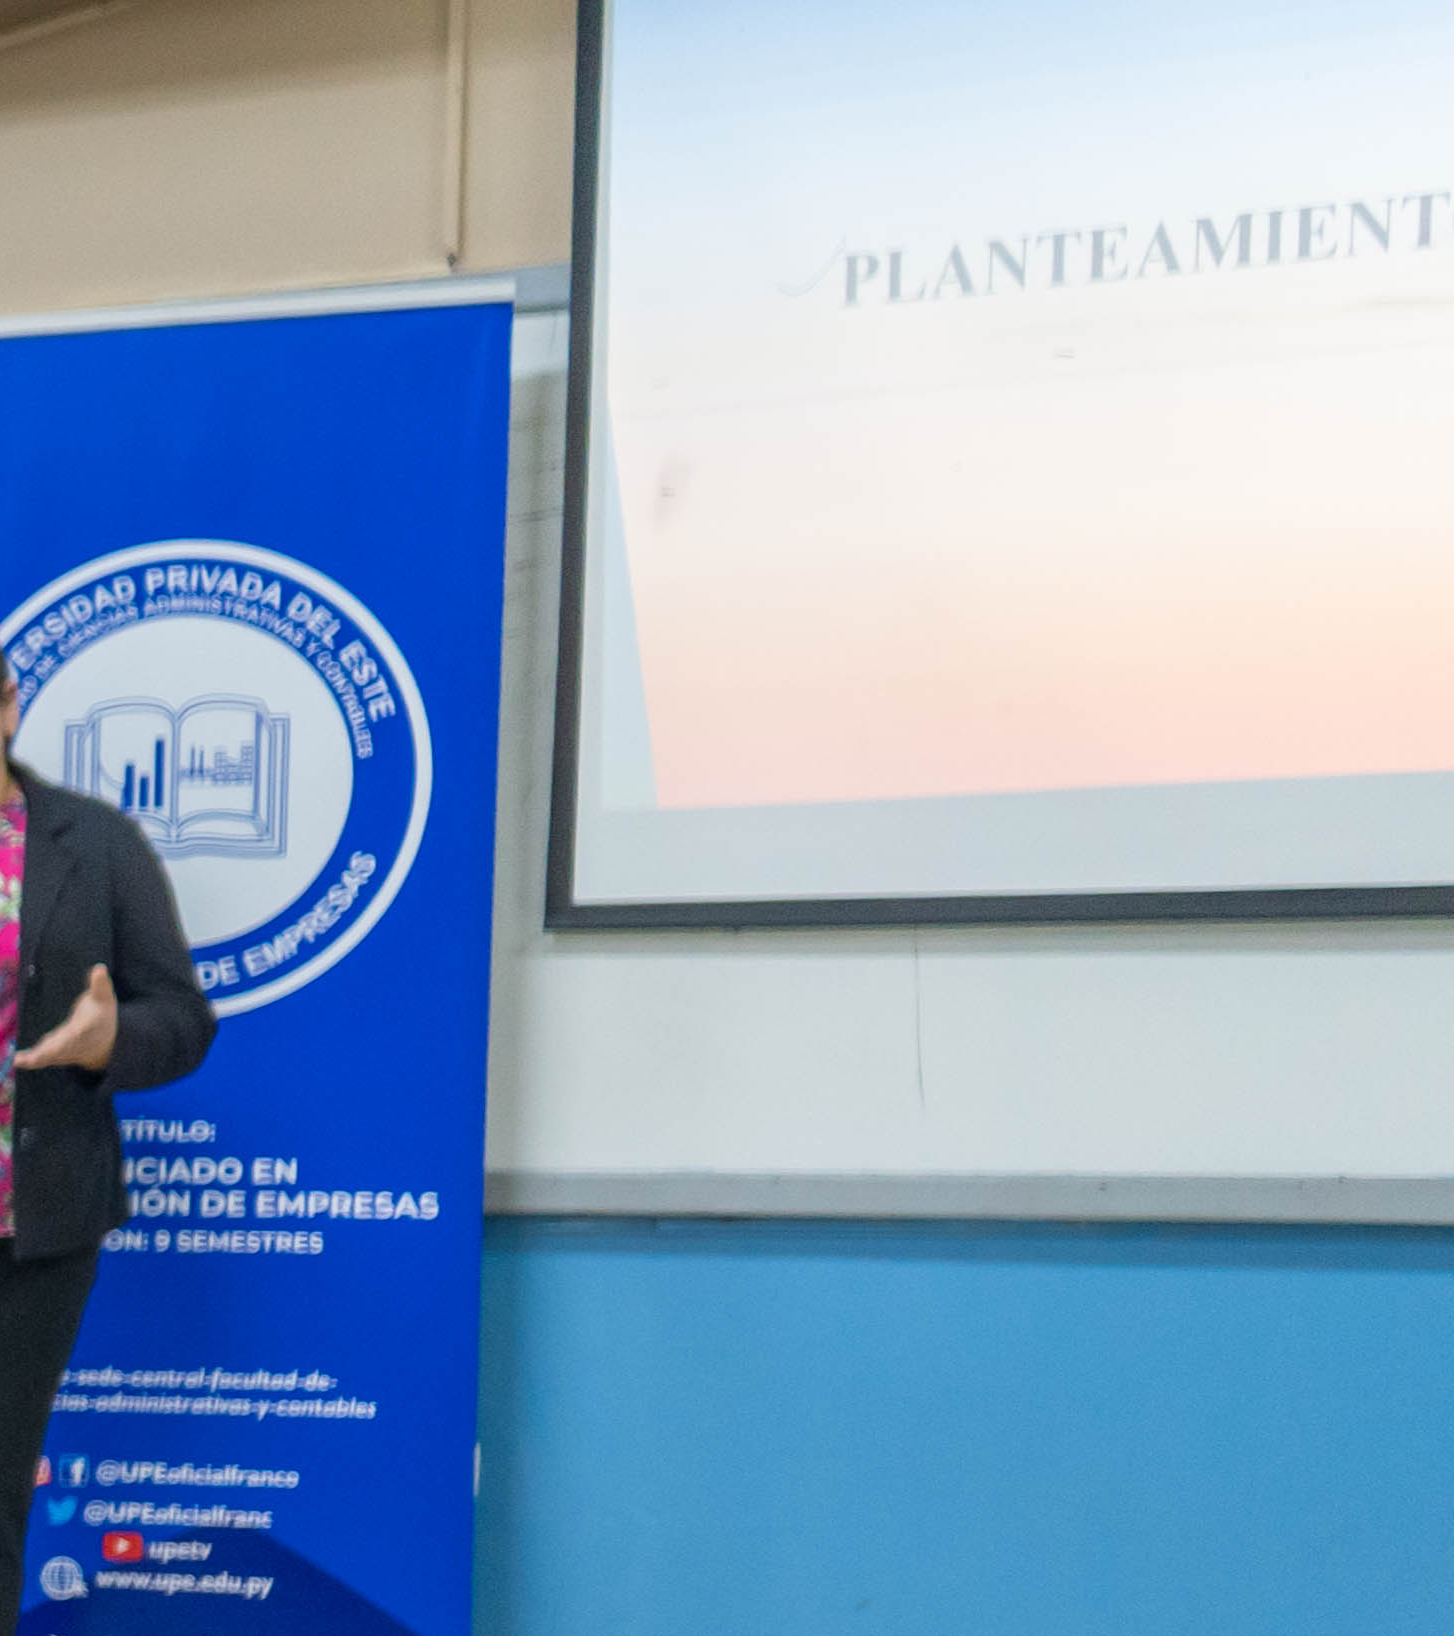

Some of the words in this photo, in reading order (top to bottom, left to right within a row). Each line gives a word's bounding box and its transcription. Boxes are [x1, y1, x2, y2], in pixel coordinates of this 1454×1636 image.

[842, 190, 1454, 308] PLANTEAMIENT
[8, 574, 136, 671] ERSIDAD
[144, 564, 281, 611] PRIVADA
[286, 592, 341, 648] DEL
[339, 639, 396, 722] ESTE
[196, 955, 240, 991] DE
[243, 850, 376, 977] EMPRESAS
[121, 1115, 216, 1143] TÍTULO:
[251, 1157, 297, 1185] EN
[200, 1189, 246, 1218] DE
[256, 1190, 439, 1220] EMPRESAS
[154, 1230, 171, 1252] 9
[176, 1230, 324, 1255] SEMESTRES
[96, 1458, 299, 1489] @UPEoficialfranco
[84, 1499, 273, 1529] @UPEoficialfranc
[96, 1571, 274, 1599] www.upe.edu.py
